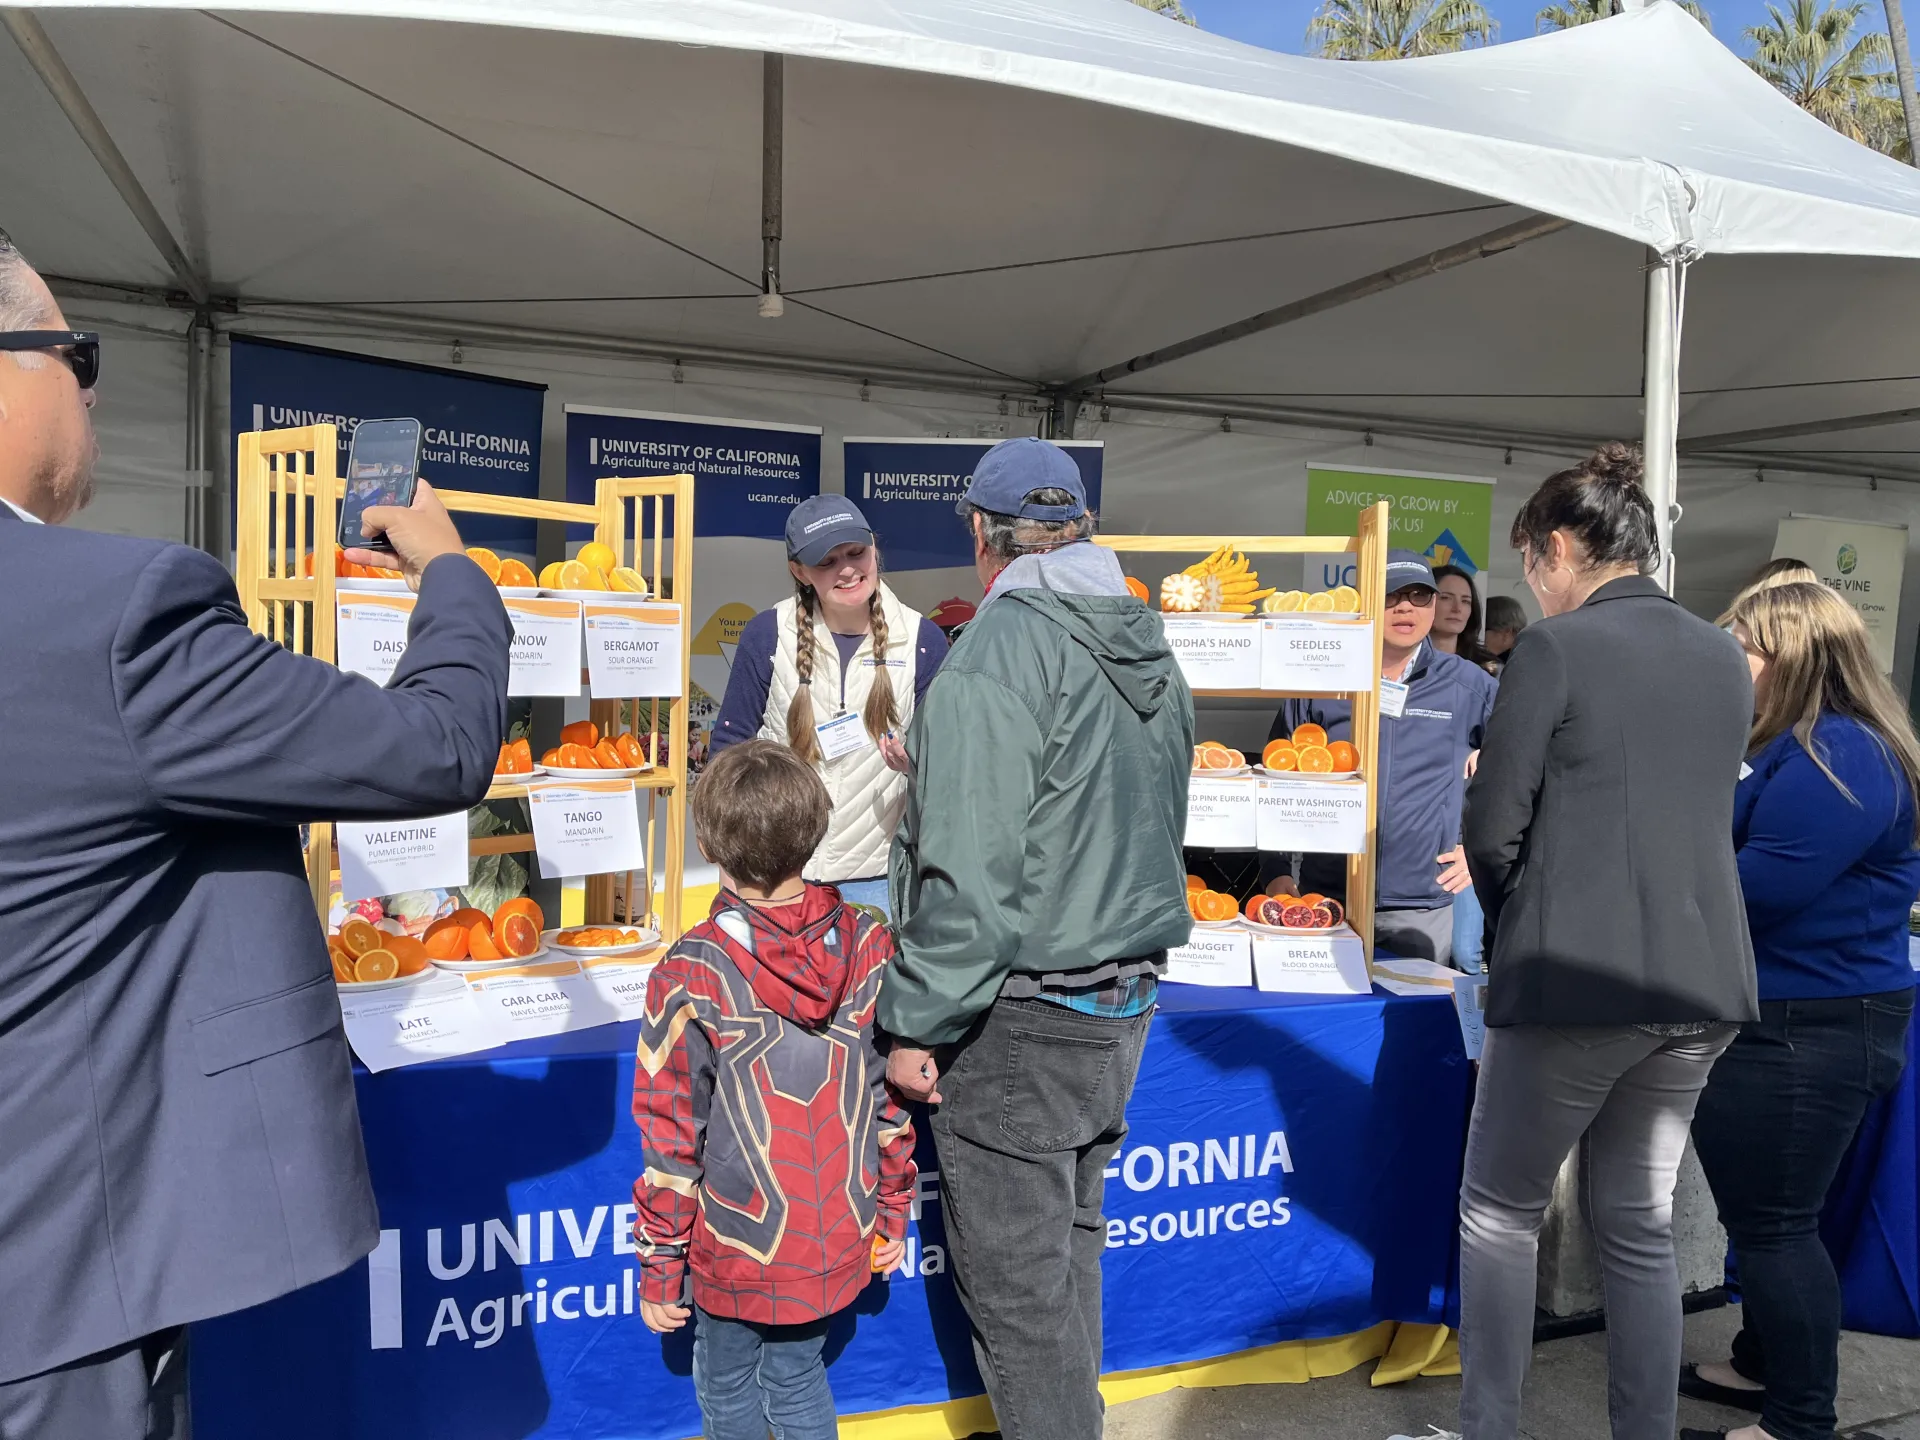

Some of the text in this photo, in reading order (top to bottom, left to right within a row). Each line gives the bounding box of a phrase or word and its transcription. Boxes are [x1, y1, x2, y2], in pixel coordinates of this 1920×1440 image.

[270, 406, 531, 456] UNIVERSI CALIFORNIA
[602, 438, 800, 467] UNIVERSITY OF CALIFORNIA
[422, 450, 530, 473] tural Resources
[602, 454, 800, 480] Agriculture and Natural Resources
[874, 472, 974, 488] UNIVERSITY O
[748, 492, 800, 505] ucanr.edu
[874, 488, 966, 502] Agriculture and
[1325, 489, 1373, 507] ADVICE
[1400, 495, 1440, 512] GROW
[1444, 500, 1459, 515] BY
[1387, 516, 1424, 533] SK US!
[1823, 578, 1871, 592] THE VINE
[719, 618, 736, 627] You
[512, 634, 548, 647] NNOW
[604, 640, 660, 652] BERGAMOT
[1169, 637, 1252, 648] UDDHA'S HAND
[1289, 640, 1342, 650] SEEDLESS
[510, 651, 543, 660] ANDARIN
[608, 656, 654, 665] SOUR ORANGE
[1303, 654, 1330, 662] LEMON
[1200, 794, 1218, 802] PINK
[1220, 795, 1251, 803] EUREKA
[1258, 797, 1362, 808] PARENT WASHINGTON
[1188, 804, 1214, 812] EMON
[1281, 810, 1338, 819] NAVEL ORANGE
[564, 811, 603, 823] TANGO
[365, 827, 437, 846] VALENTINE
[565, 827, 604, 837] MANDARIN
[368, 844, 434, 858] PUMMELO HYBRID
[1189, 942, 1235, 952] NUGGET
[1175, 952, 1215, 960] MANDARIN
[1288, 950, 1328, 959] BREAM
[612, 980, 649, 994] NAGAM
[502, 991, 569, 1007] CARA CARA
[623, 993, 647, 1001] KUMQ
[511, 1007, 537, 1017] NAVEL
[537, 1002, 571, 1013] ORANGE
[399, 1017, 432, 1031] LATE
[403, 1029, 439, 1041] VALENCIA
[427, 1131, 1295, 1281] UNIVE F FORNIA
[426, 1197, 1292, 1349] Agricul esources
